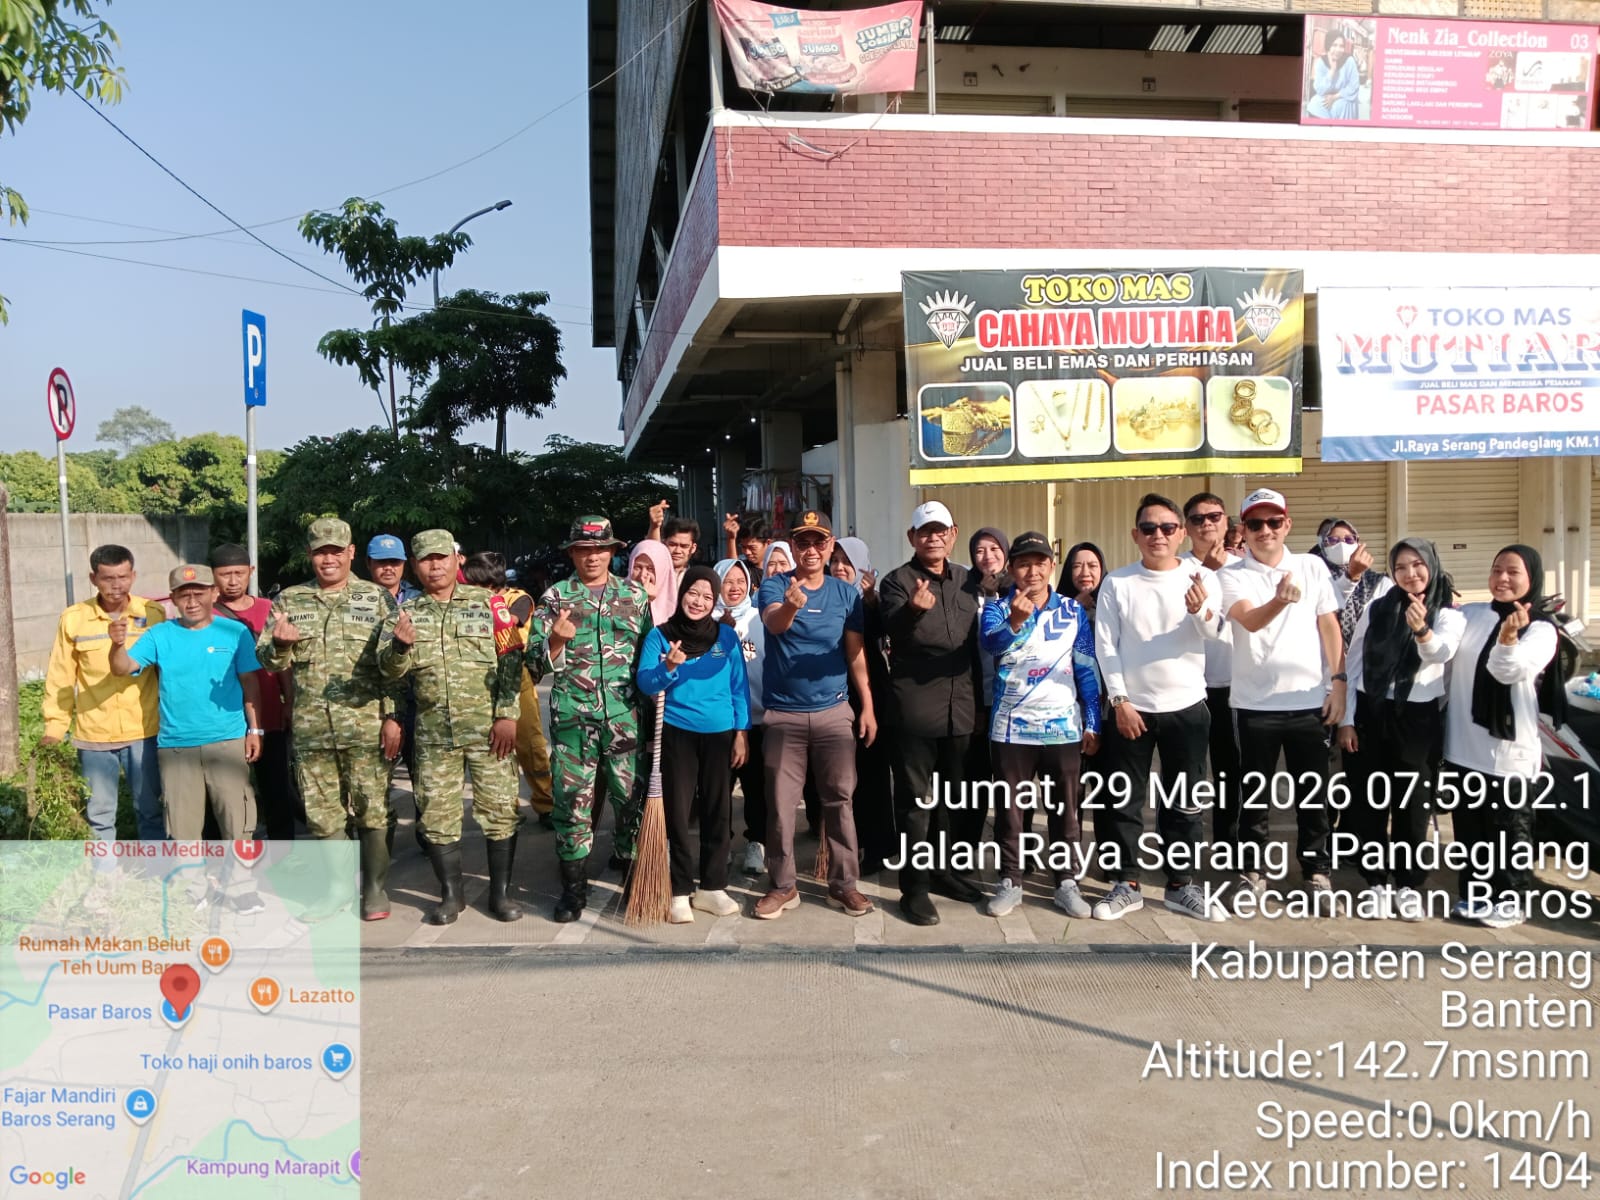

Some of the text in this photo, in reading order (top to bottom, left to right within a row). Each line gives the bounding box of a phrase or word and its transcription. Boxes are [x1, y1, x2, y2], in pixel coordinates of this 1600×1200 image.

[857, 17, 911, 43] JUMBO
[1388, 28, 1429, 45] Nenk
[1570, 33, 1589, 49] 03
[802, 43, 839, 55] JUMBO
[1022, 274, 1193, 304] TOKO MAS
[1426, 307, 1572, 327] TOKO MAS
[977, 309, 1235, 349] CAHAYA MUTIARA
[247, 324, 262, 388] P
[960, 352, 1253, 372] JUAL BELI EMAS DAN PERHIASAN
[1419, 381, 1439, 389] JUAL
[1441, 380, 1458, 388] BELI
[57, 384, 68, 426] P
[1416, 392, 1584, 415] PASAR BAROS
[1392, 440, 1439, 455] Jl.Raya
[1442, 439, 1486, 453] Serang
[1489, 436, 1562, 451] Pandeglang
[478, 611, 490, 619] AD
